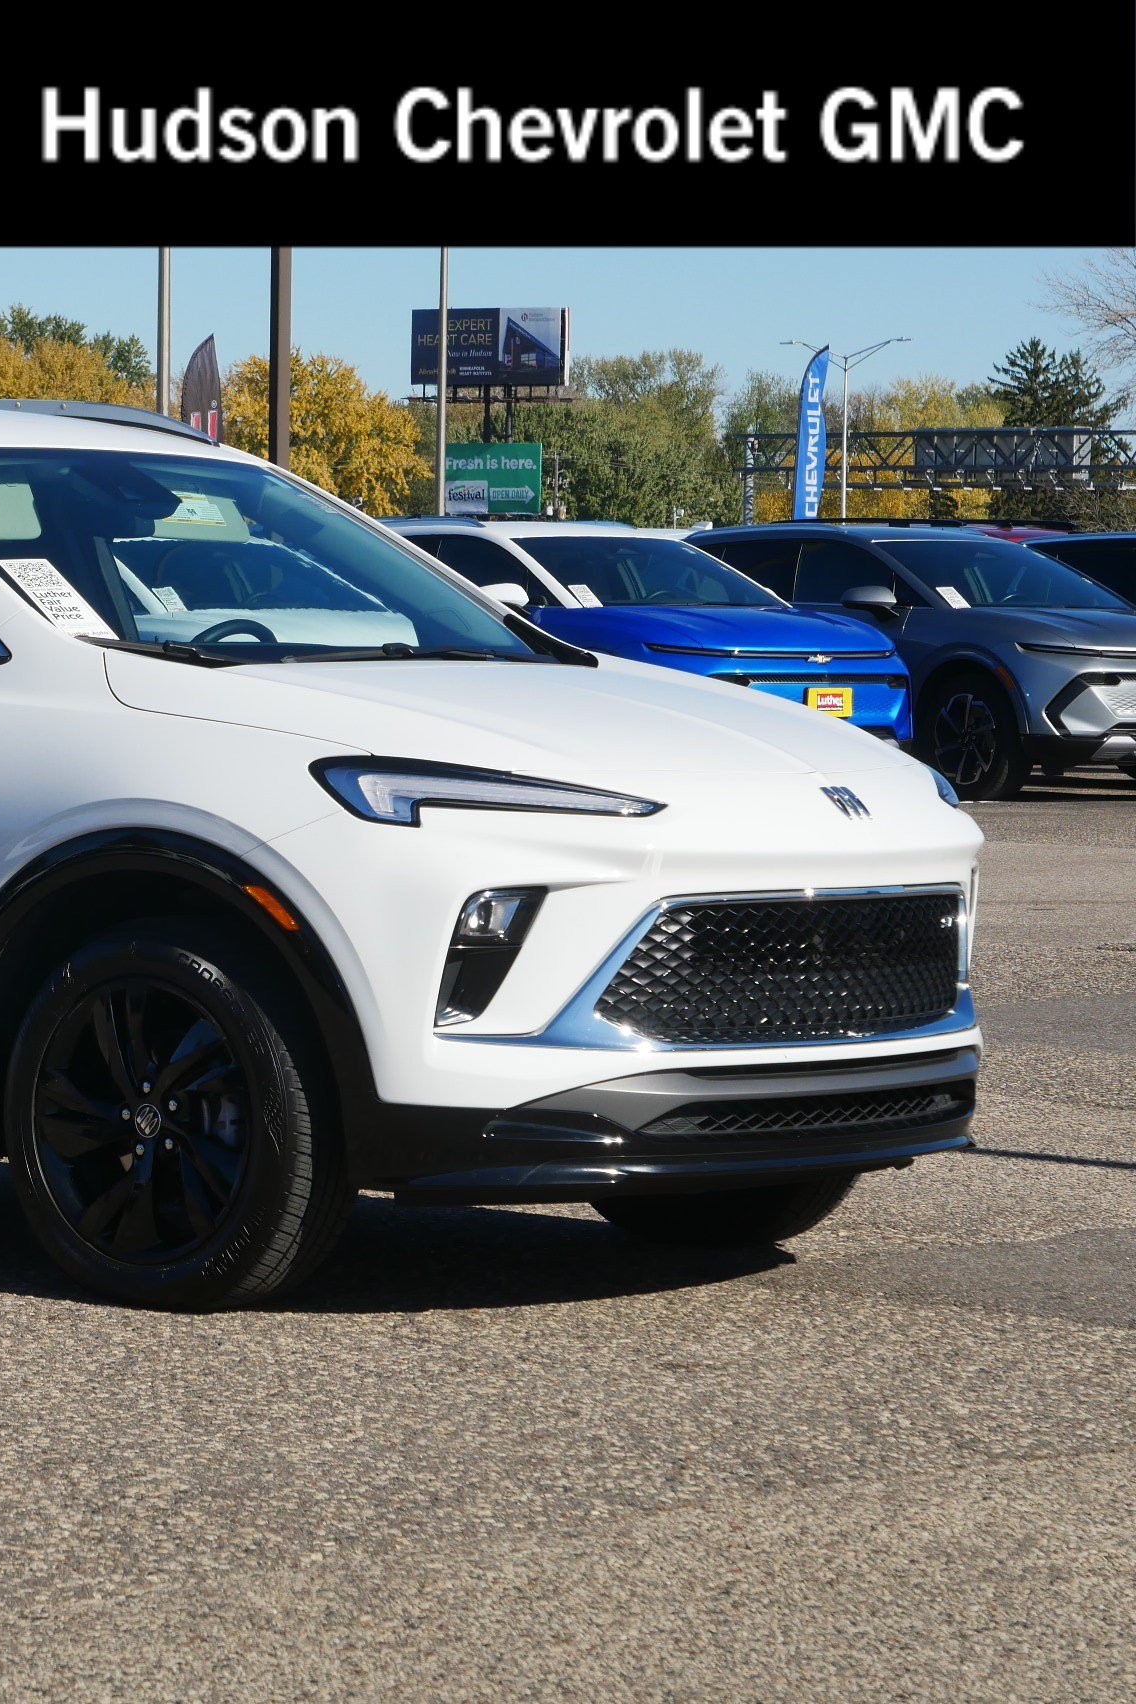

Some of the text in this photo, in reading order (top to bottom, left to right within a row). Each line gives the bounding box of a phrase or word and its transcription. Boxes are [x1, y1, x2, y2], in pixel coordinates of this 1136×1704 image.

[448, 319, 493, 331] EXPERT
[460, 333, 493, 346] CARE
[469, 350, 493, 358] Hudson
[805, 370, 821, 518] CHEVROLET
[445, 454, 537, 470] Fresh is here.
[448, 488, 485, 501] festival
[492, 490, 529, 499] OPEN DAILY
[32, 590, 73, 599] Luther
[39, 598, 62, 606] Fair
[45, 605, 81, 613] Value
[51, 612, 85, 620] Price
[817, 694, 843, 706] Luther
